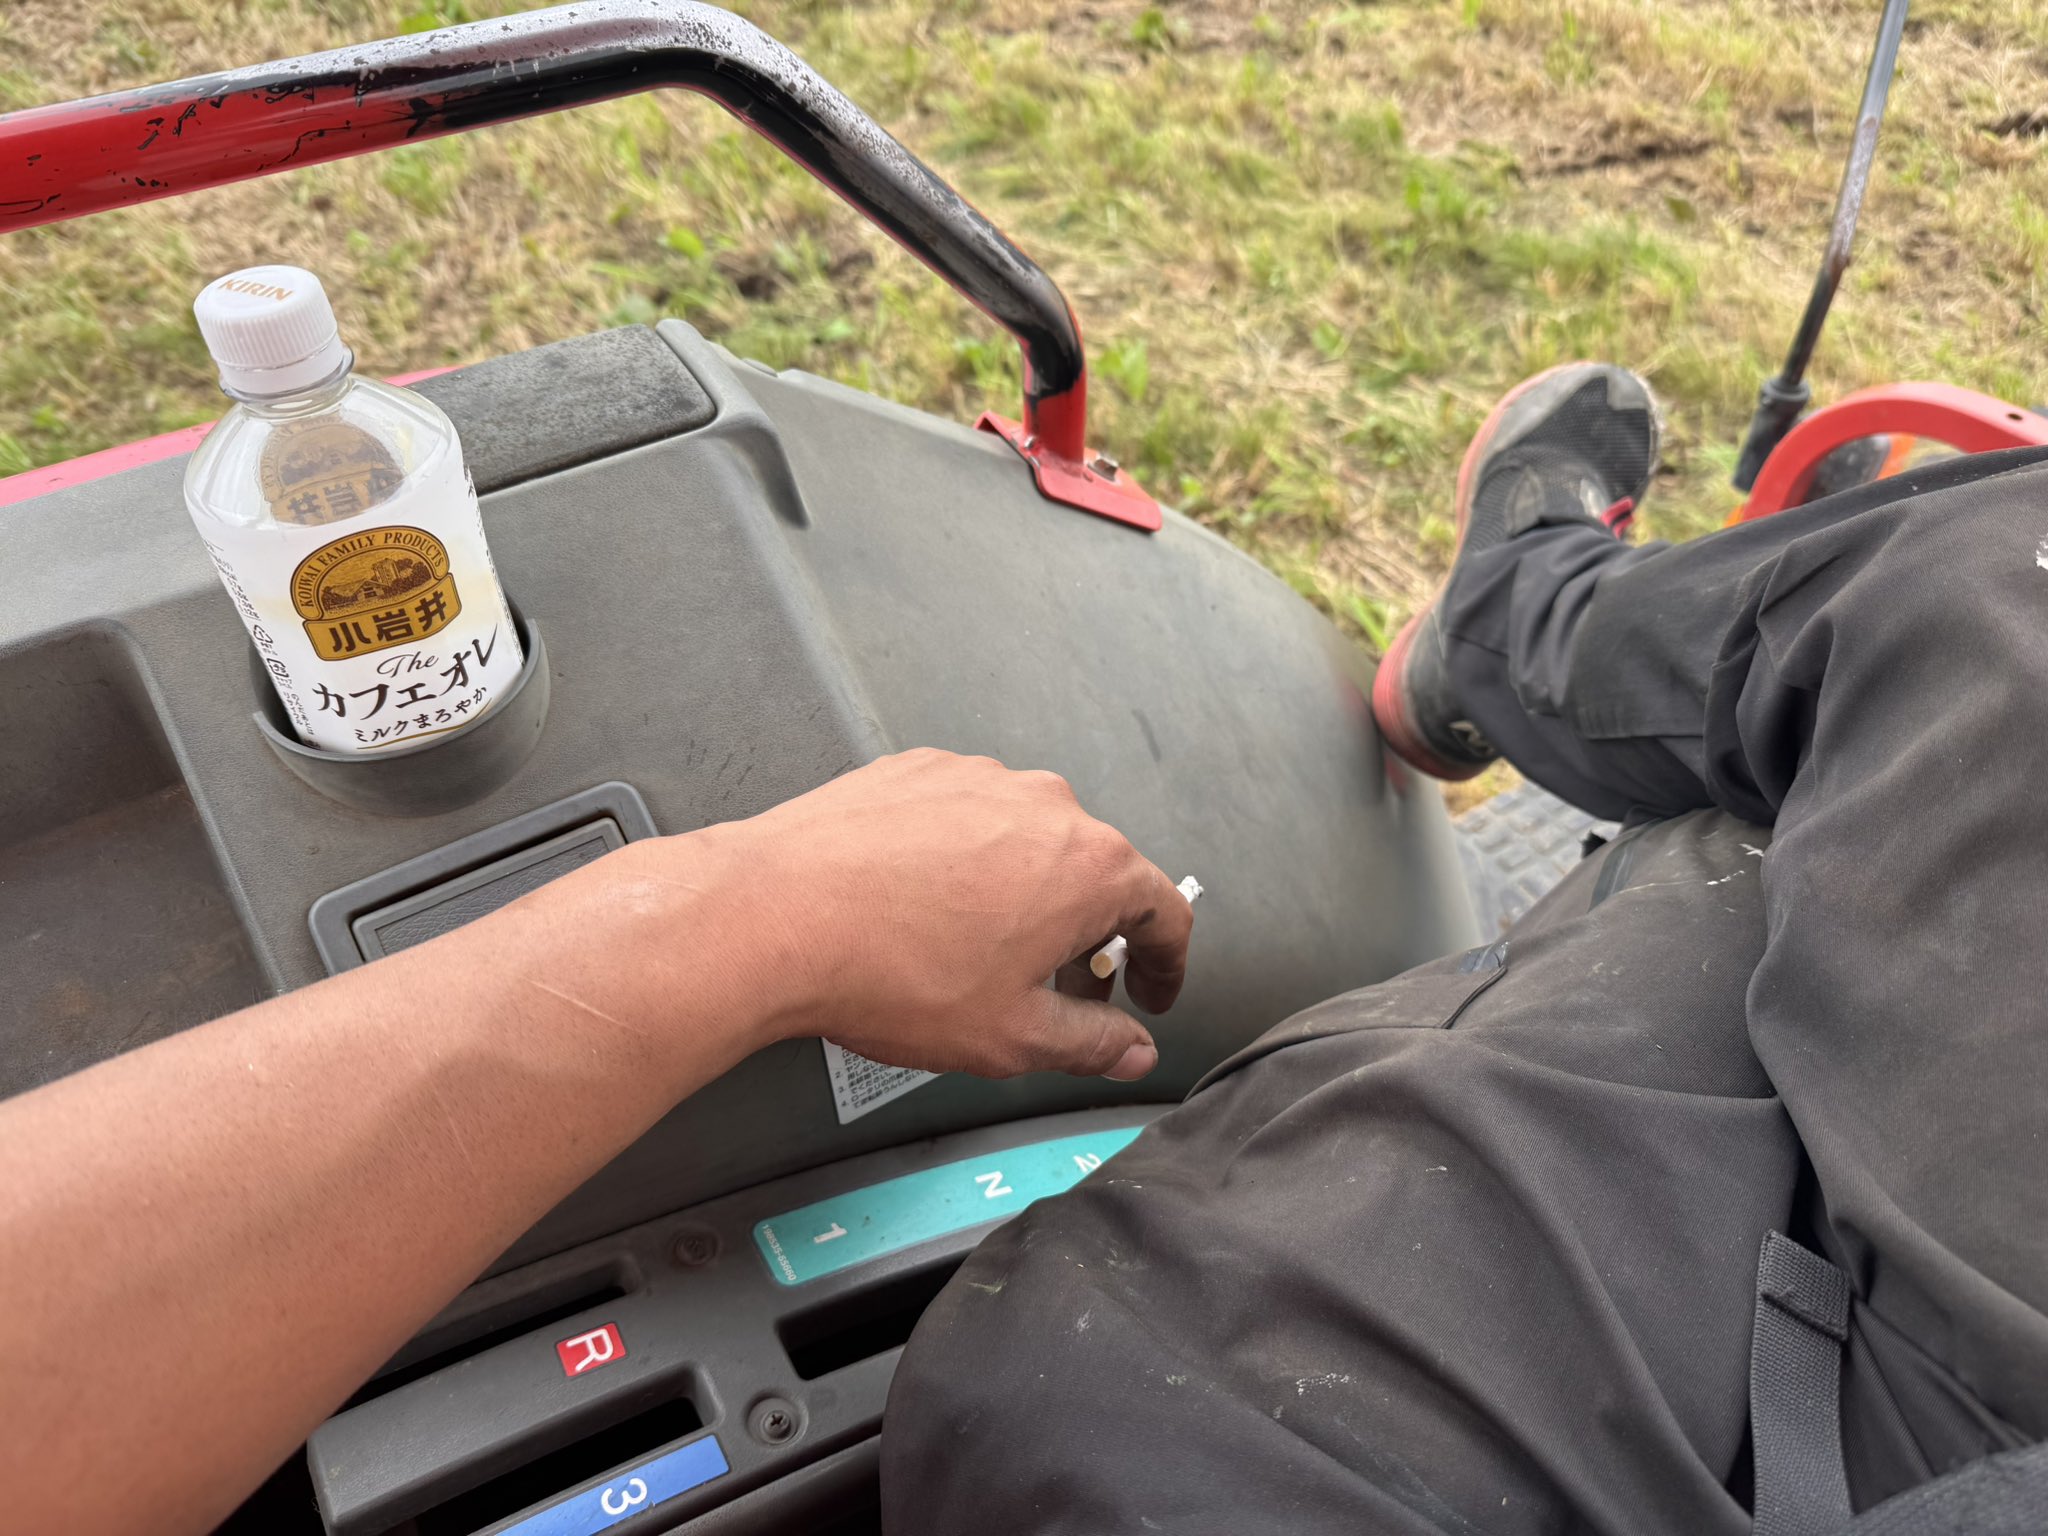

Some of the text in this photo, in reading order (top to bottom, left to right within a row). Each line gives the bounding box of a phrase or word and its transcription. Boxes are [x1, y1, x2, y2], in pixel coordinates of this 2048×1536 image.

[217, 278, 295, 301] KIRIN
[298, 565, 322, 608] KOIWAI
[316, 534, 376, 567] FAMILY
[383, 531, 446, 568] PRODUCTS
[328, 590, 447, 653] 小岩井
[376, 650, 439, 678] The
[354, 686, 488, 743] ミルクまろやか
[1072, 1152, 1102, 1174] 2
[974, 1170, 1013, 1198] N
[813, 1222, 848, 1244] 1
[566, 1328, 614, 1372] R
[601, 1477, 648, 1515] 3
